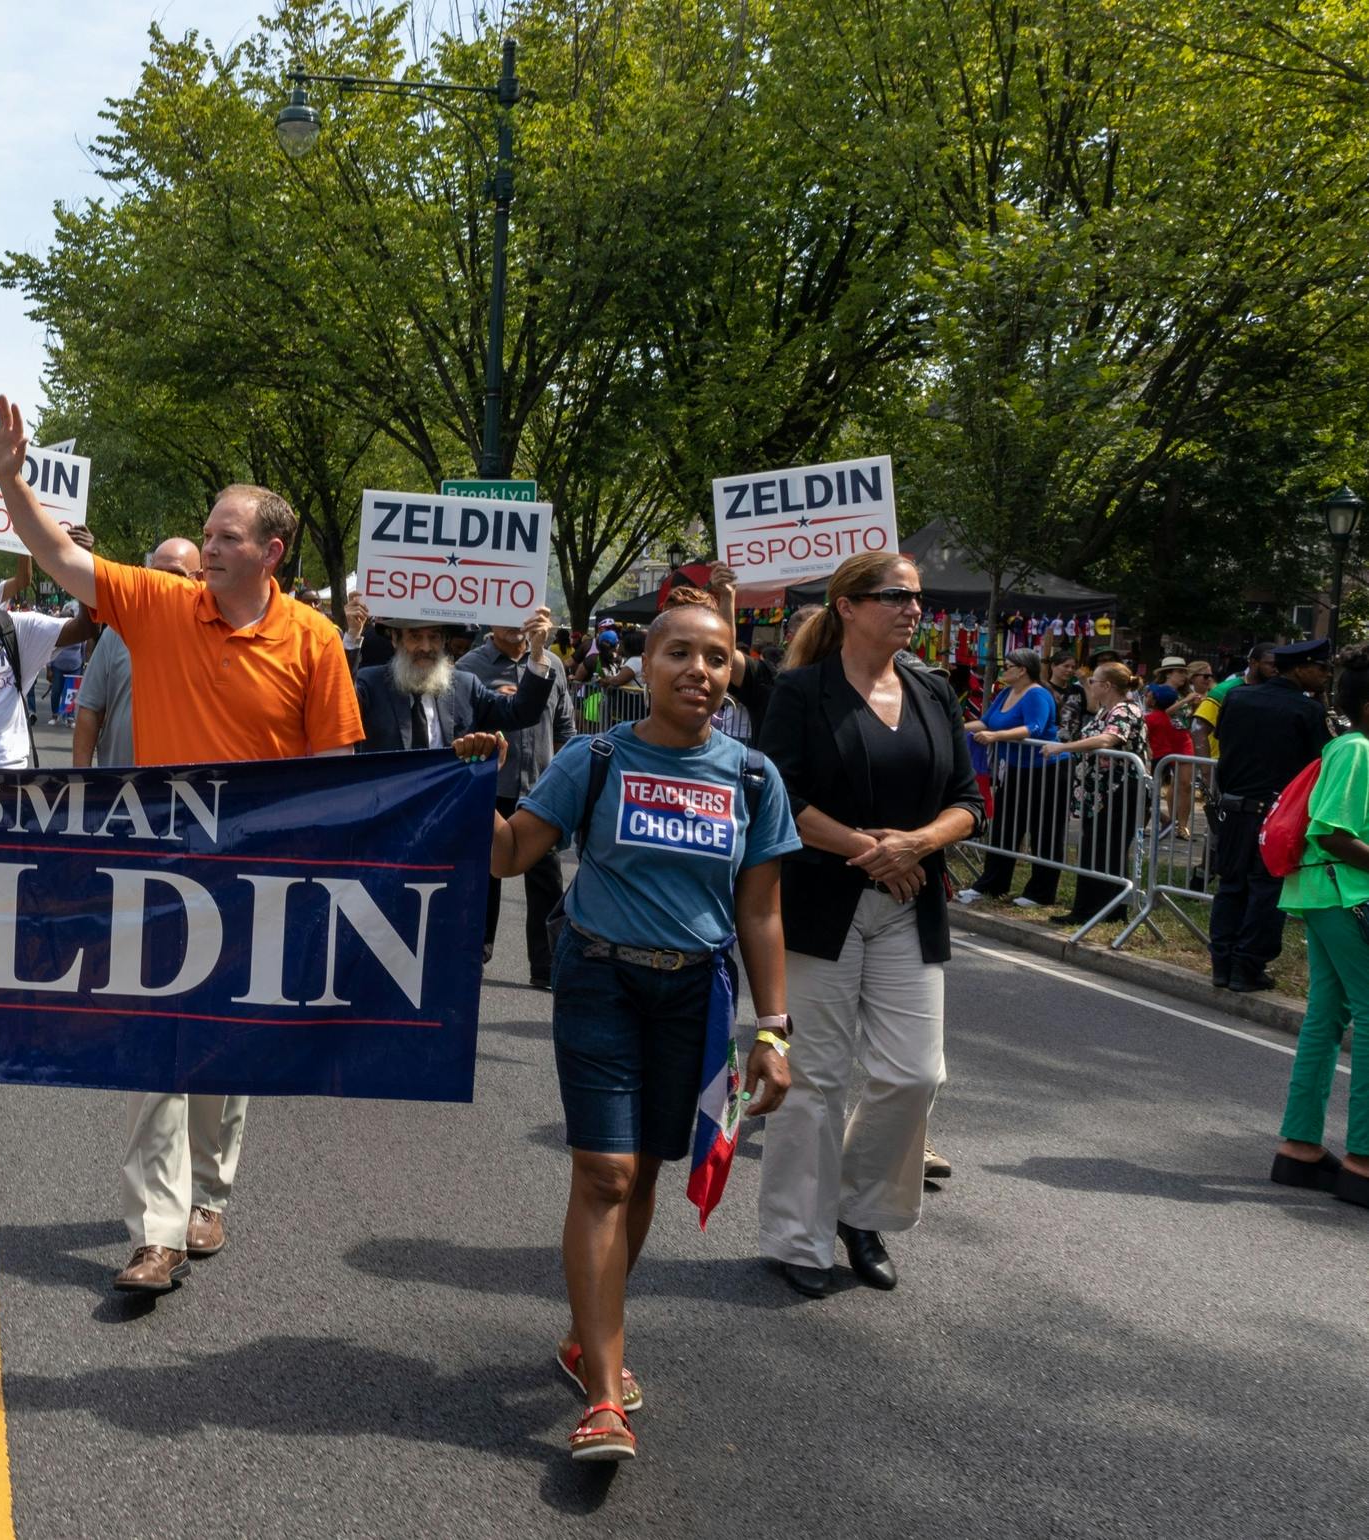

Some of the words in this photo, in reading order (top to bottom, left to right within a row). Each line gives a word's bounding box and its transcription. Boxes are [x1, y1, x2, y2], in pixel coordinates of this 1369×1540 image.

[723, 465, 883, 520] ZELDIN
[371, 501, 540, 553] ZELDIN
[726, 526, 887, 568] ESPOSITO
[365, 568, 535, 609] ESPOSITO
[627, 781, 725, 814] TEACHERS
